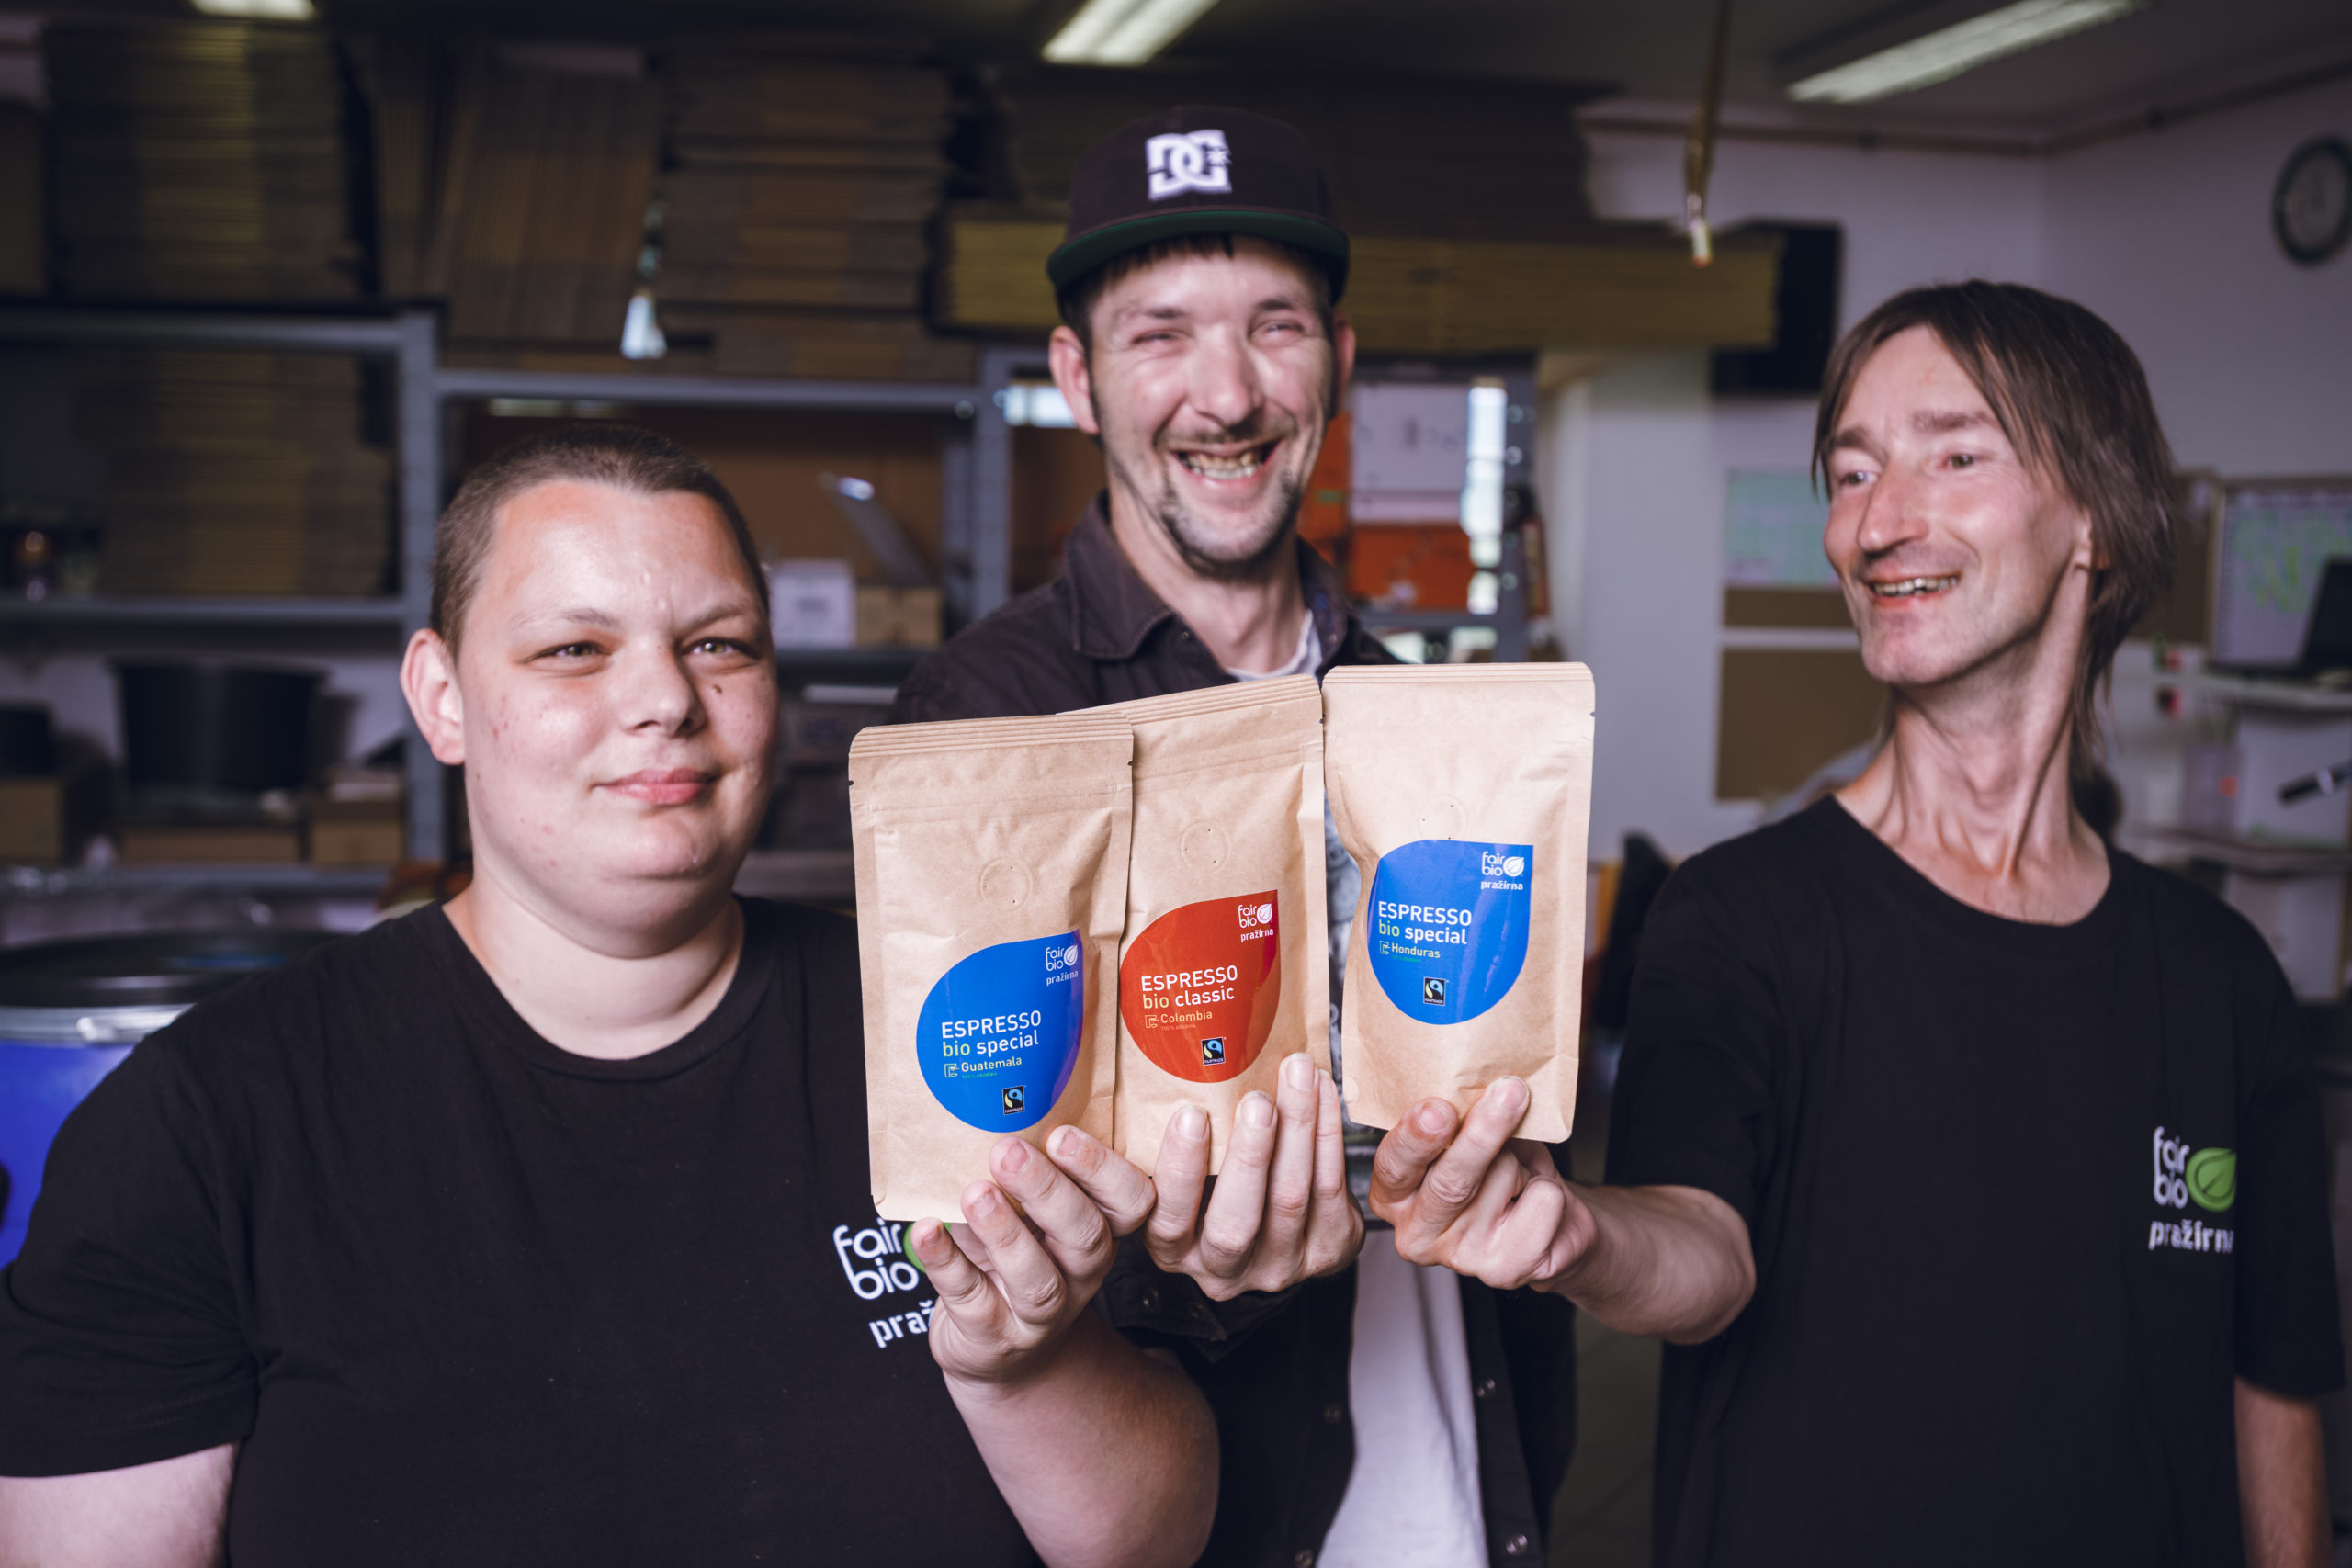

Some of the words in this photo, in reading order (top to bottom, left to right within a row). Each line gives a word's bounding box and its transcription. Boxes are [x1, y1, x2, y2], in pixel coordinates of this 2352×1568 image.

[1481, 851, 1506, 865] fair
[1481, 864, 1503, 876] bio
[1238, 904, 1257, 917] fair
[1378, 901, 1472, 927] ESPRESSO
[1238, 917, 1257, 928] bio
[1379, 919, 1400, 937] bio
[1405, 927, 1468, 945] special
[1045, 946, 1065, 959] fair
[1391, 942, 1441, 958] Honduras
[1046, 958, 1064, 972] bio
[1141, 964, 1238, 992] ESPRESSO
[1142, 994, 1169, 1010] bio
[1175, 986, 1235, 1007] classic
[942, 1010, 1042, 1039] ESPRESSO
[1160, 1010, 1213, 1023] Colombia
[943, 1041, 970, 1057] bio
[977, 1030, 1039, 1057] special
[961, 1055, 1022, 1072] Guatemala
[2154, 1169, 2188, 1209] bio
[832, 1217, 902, 1259] fair
[843, 1257, 920, 1300] bio
